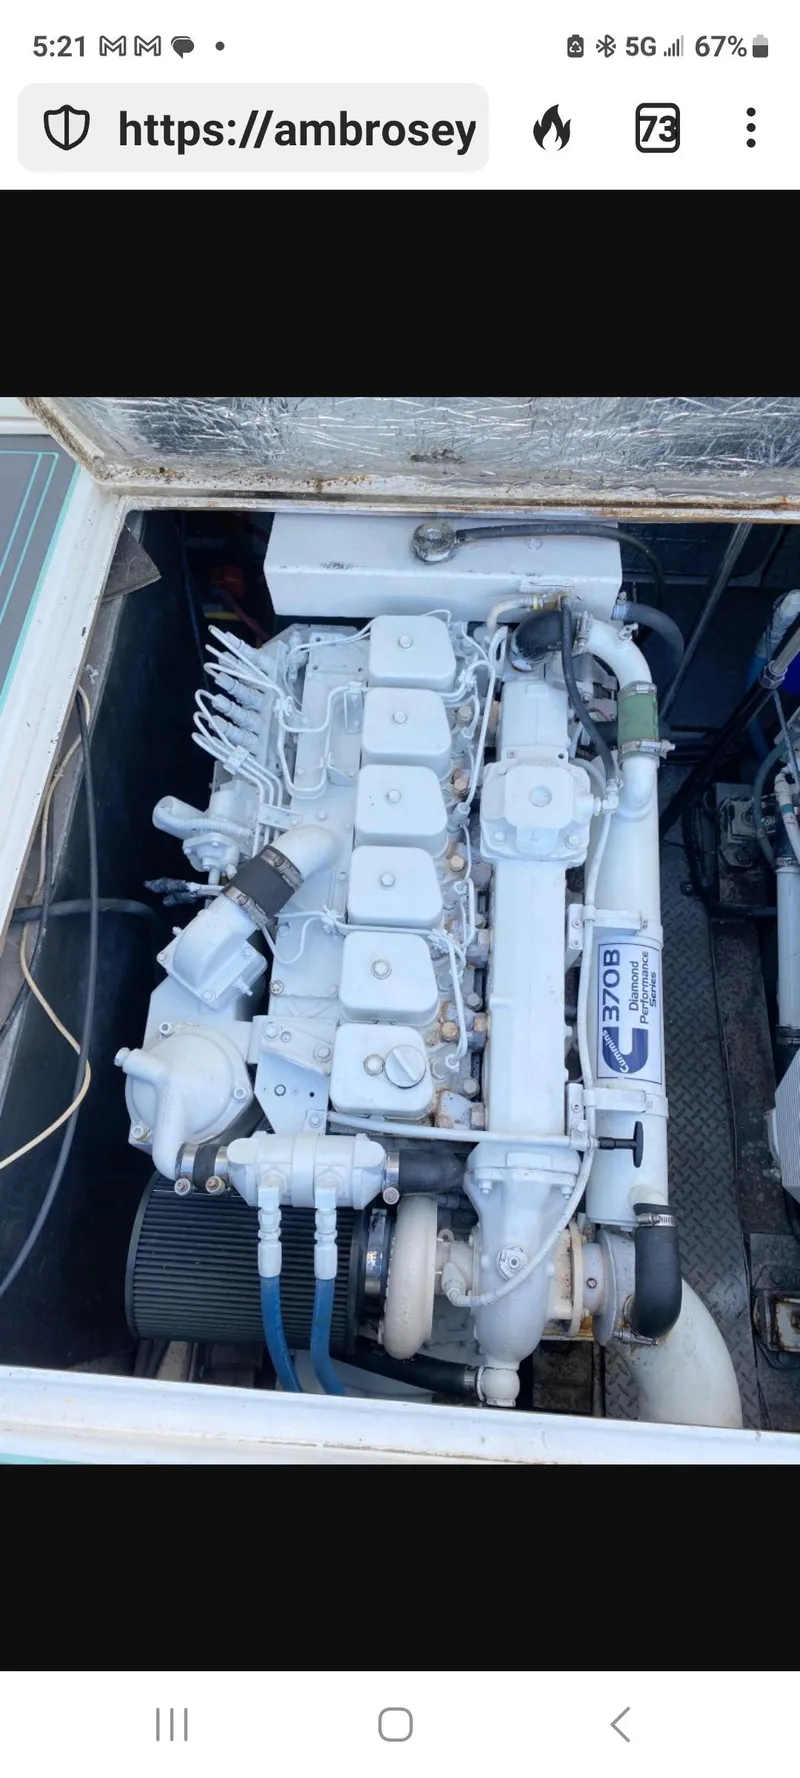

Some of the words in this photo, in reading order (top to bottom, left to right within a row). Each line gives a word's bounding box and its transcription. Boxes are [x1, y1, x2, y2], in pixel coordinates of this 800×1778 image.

[603, 949, 620, 1022] 370B
[629, 960, 639, 1011] Diamond
[640, 951, 649, 1025] Performance
[603, 1029, 630, 1074] Cummins
